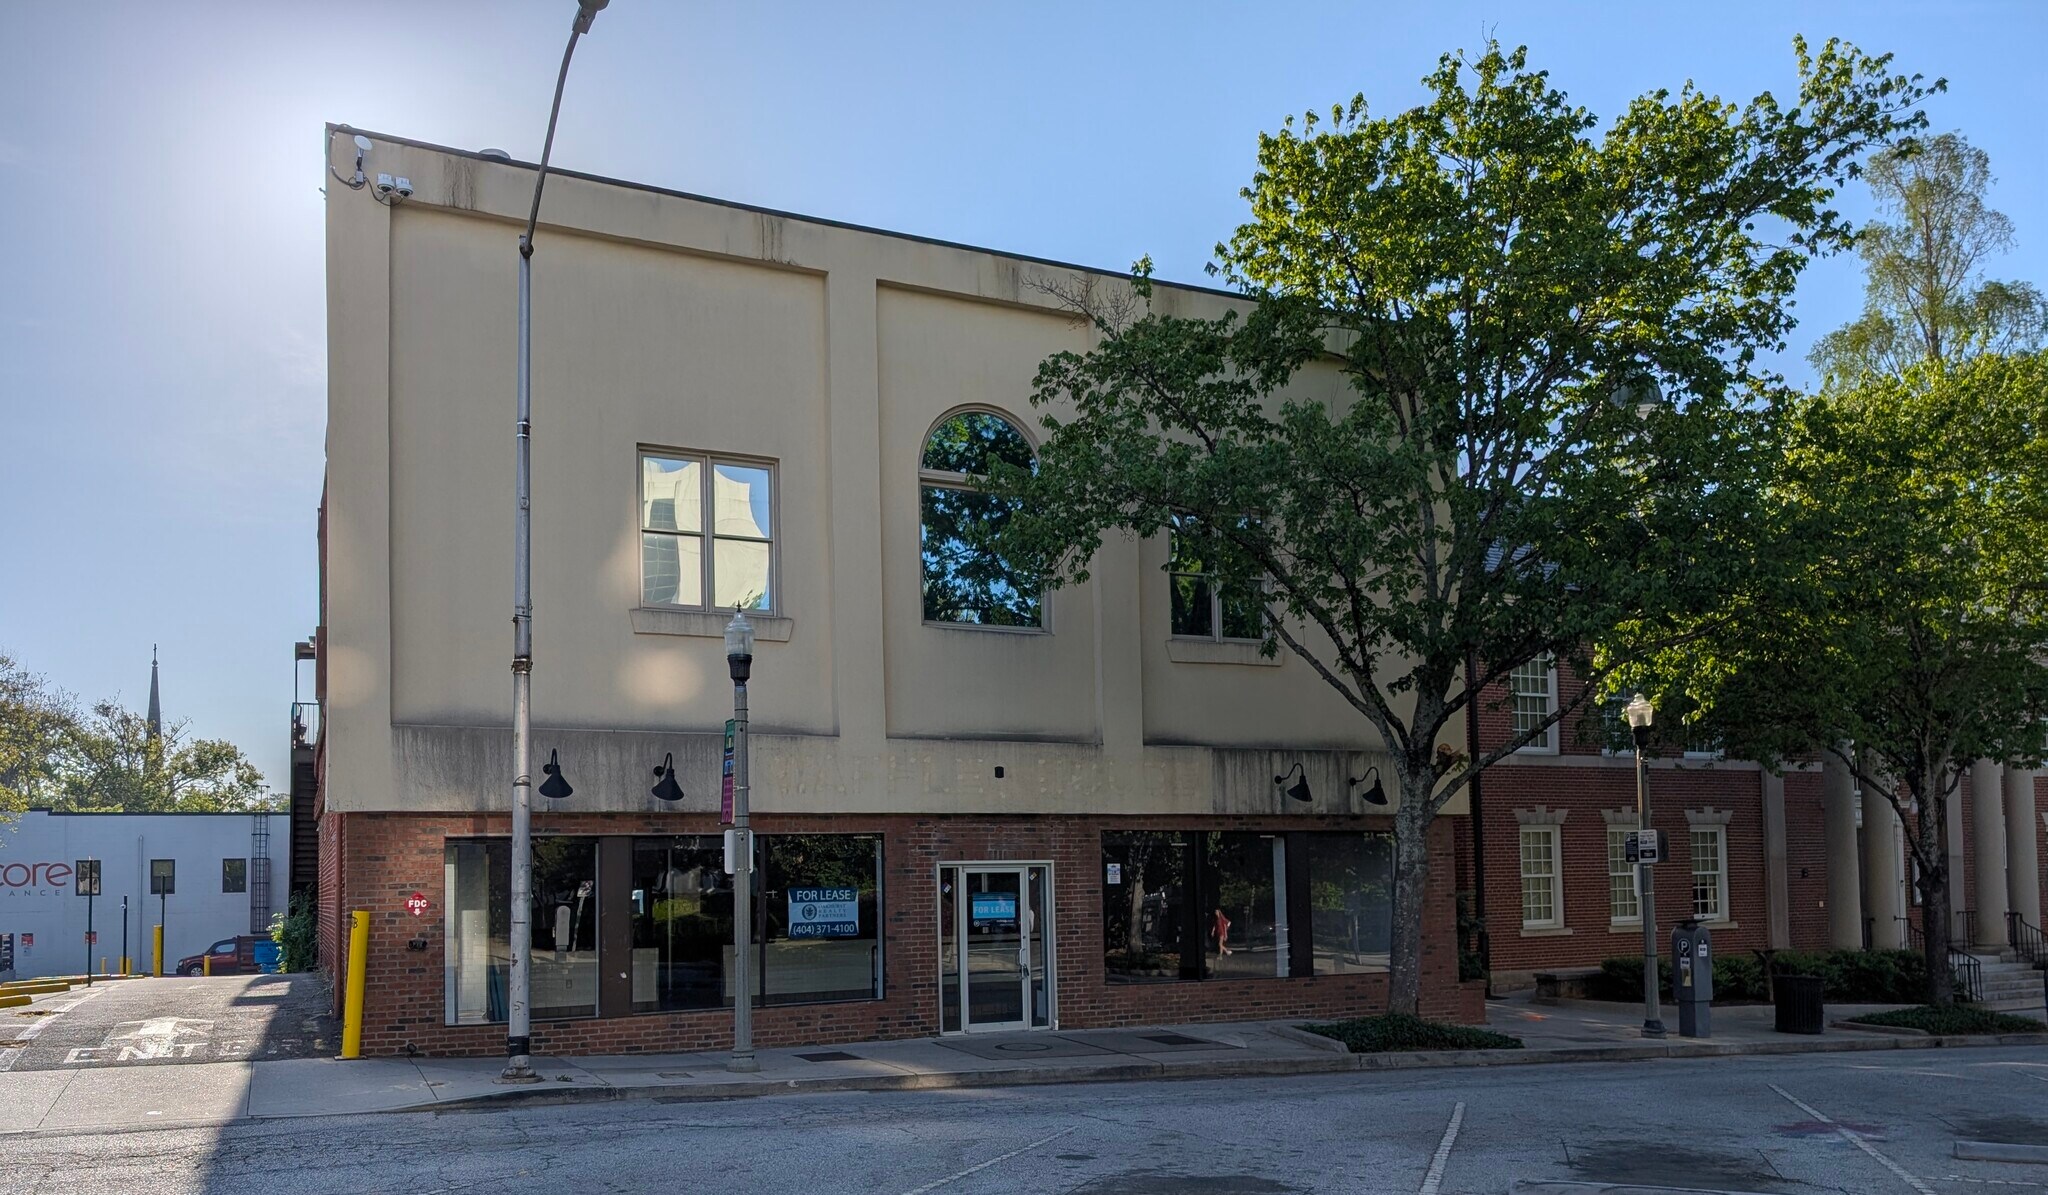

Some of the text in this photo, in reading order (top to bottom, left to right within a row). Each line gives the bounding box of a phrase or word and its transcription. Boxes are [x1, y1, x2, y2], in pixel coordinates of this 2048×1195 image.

[0, 863, 73, 888] ore
[797, 890, 850, 901] FOR LEASE
[974, 906, 990, 914] FOR
[793, 924, 854, 935] (404) 371-4100
[1681, 941, 1688, 951] P
